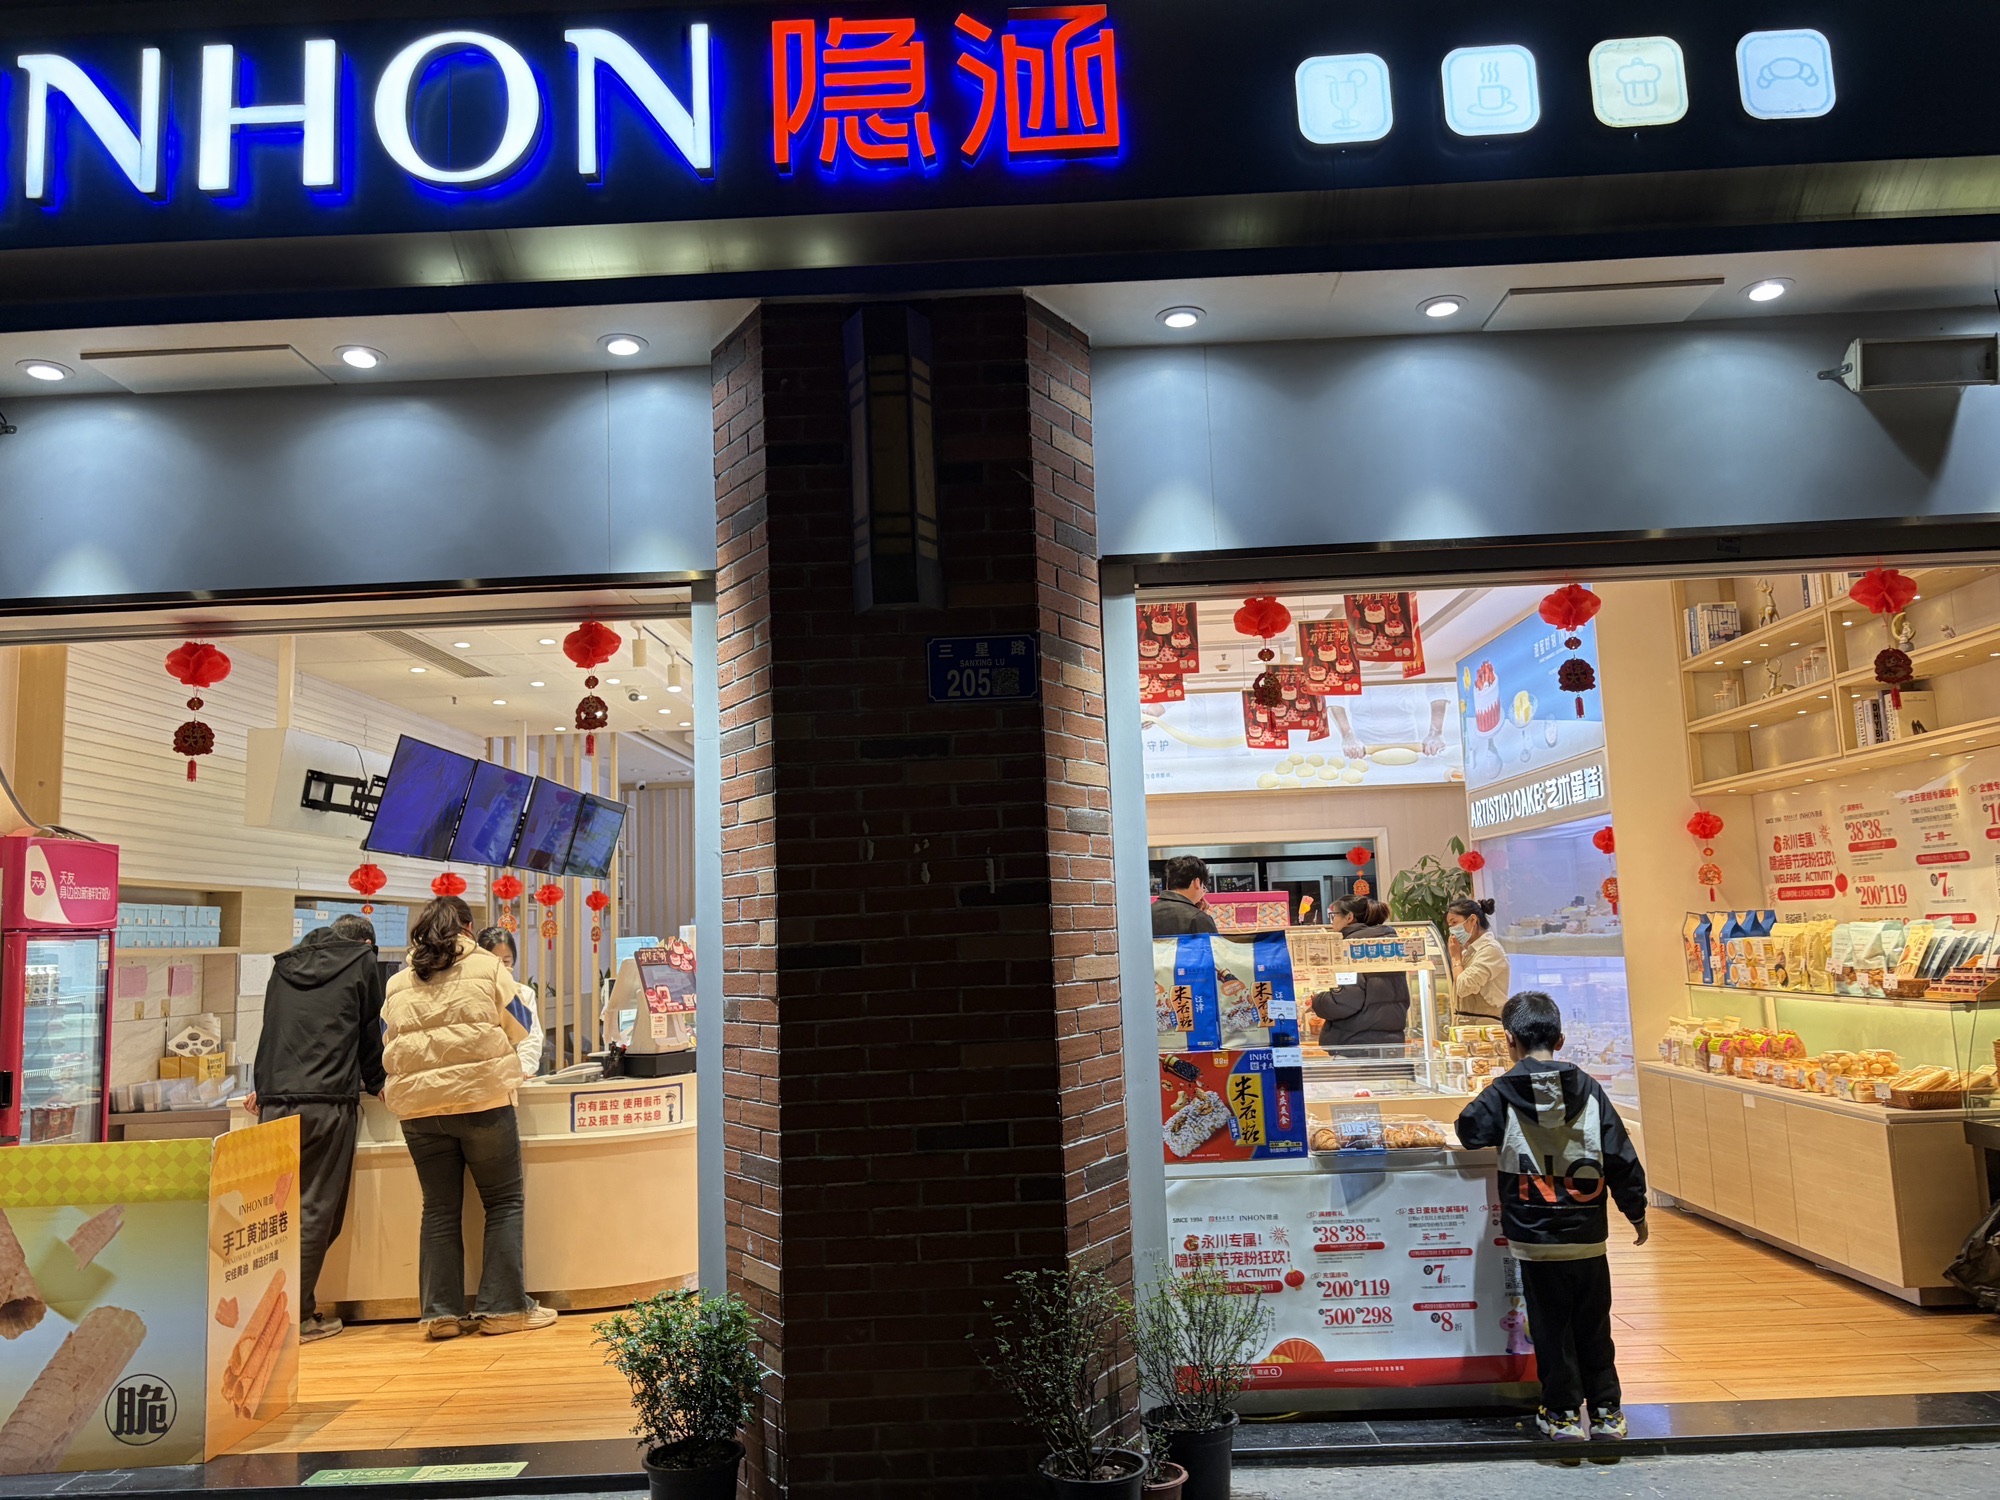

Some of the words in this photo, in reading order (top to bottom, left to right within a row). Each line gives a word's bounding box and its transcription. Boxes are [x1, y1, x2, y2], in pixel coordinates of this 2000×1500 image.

[772, 5, 1120, 163] 隐涵
[938, 640, 1026, 658] 三星路
[960, 659, 992, 667] SANXING
[995, 658, 1005, 666] LU
[947, 669, 991, 696] 205
[1546, 765, 1604, 810] 艺术蛋糕
[1774, 873, 1802, 884] WELFARE
[1805, 870, 1833, 882] ACTIVITY
[1859, 885, 1882, 905] 200
[1883, 884, 1907, 904] 119
[1173, 986, 1193, 1028] 米花糖
[577, 1100, 620, 1112] 内有监控
[623, 1095, 662, 1109] 使用假币
[1233, 1076, 1260, 1144] 米花糖
[577, 1114, 620, 1127] 立及报警
[623, 1110, 662, 1123] 绝不姑息
[1519, 1153, 1604, 1203] NO
[239, 1198, 263, 1217] INHON
[1408, 1205, 1469, 1215] 生日蛋糕专属福利
[1239, 1214, 1265, 1222] INHON
[223, 1211, 288, 1257] 手工黄油蛋卷
[1202, 1233, 1262, 1249] 永川专属!
[1318, 1226, 1340, 1243] 38
[1345, 1225, 1366, 1242] 38
[225, 1263, 249, 1283] 安佳黄油
[1237, 1268, 1282, 1278] ACTIVITY
[1322, 1280, 1353, 1298] 200
[1360, 1279, 1390, 1297] 119
[1325, 1308, 1355, 1325] 500
[1362, 1306, 1393, 1324] 298
[113, 1383, 168, 1436] 脆
